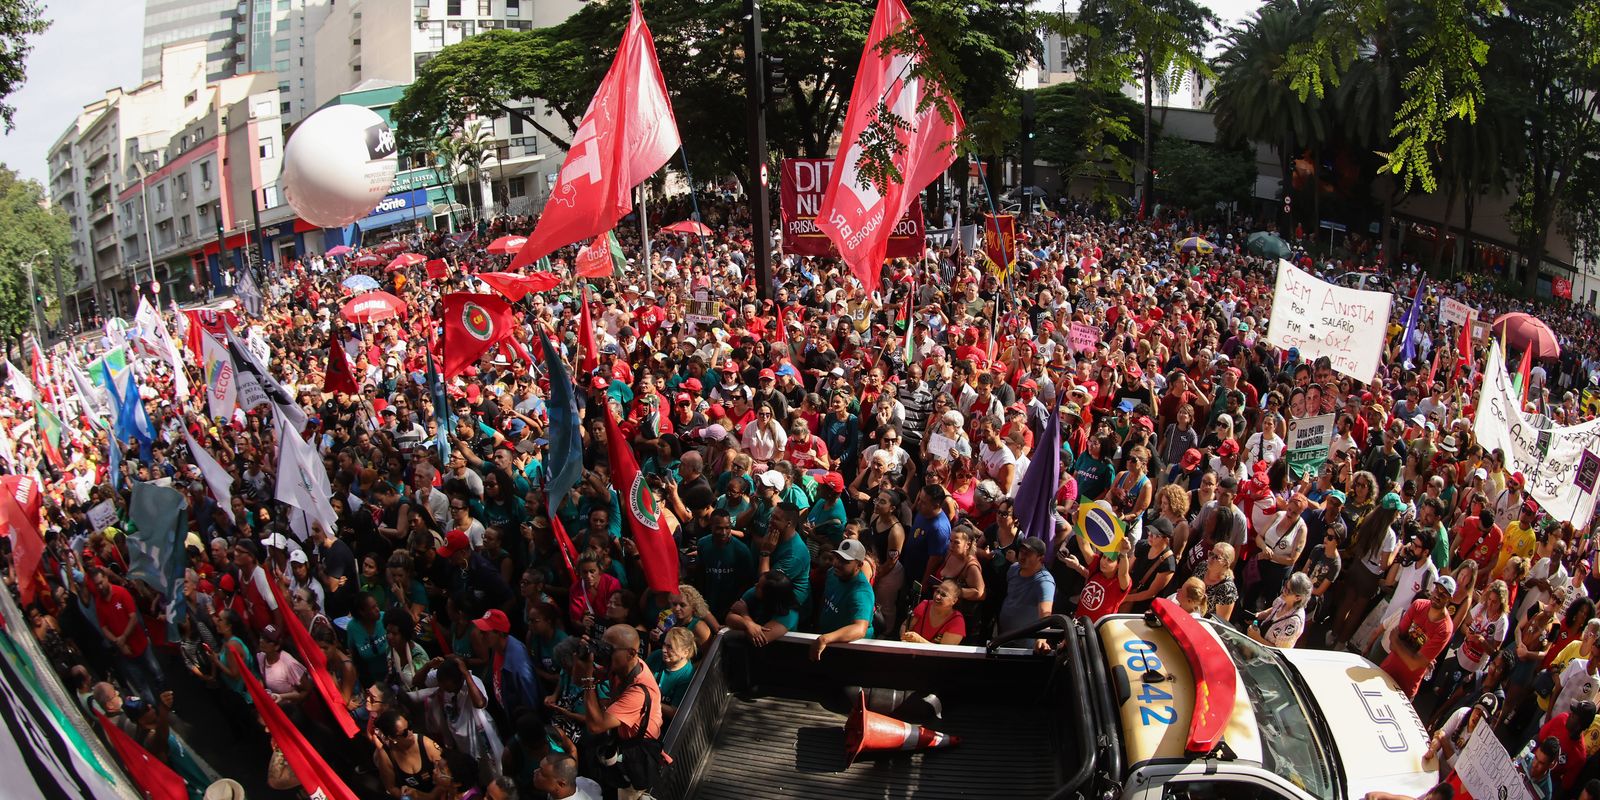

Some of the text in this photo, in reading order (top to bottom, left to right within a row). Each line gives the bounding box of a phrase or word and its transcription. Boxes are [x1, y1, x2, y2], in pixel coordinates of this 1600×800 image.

[795, 161, 835, 193] DIT
[1284, 268, 1375, 326] SEM ANISTIA
[1290, 301, 1306, 317] POR
[852, 308, 865, 320] 13
[1321, 317, 1355, 334] SALÁRIO
[1286, 319, 1302, 334] FIM
[213, 365, 234, 401] SECOR
[1123, 639, 1178, 726] 0842
